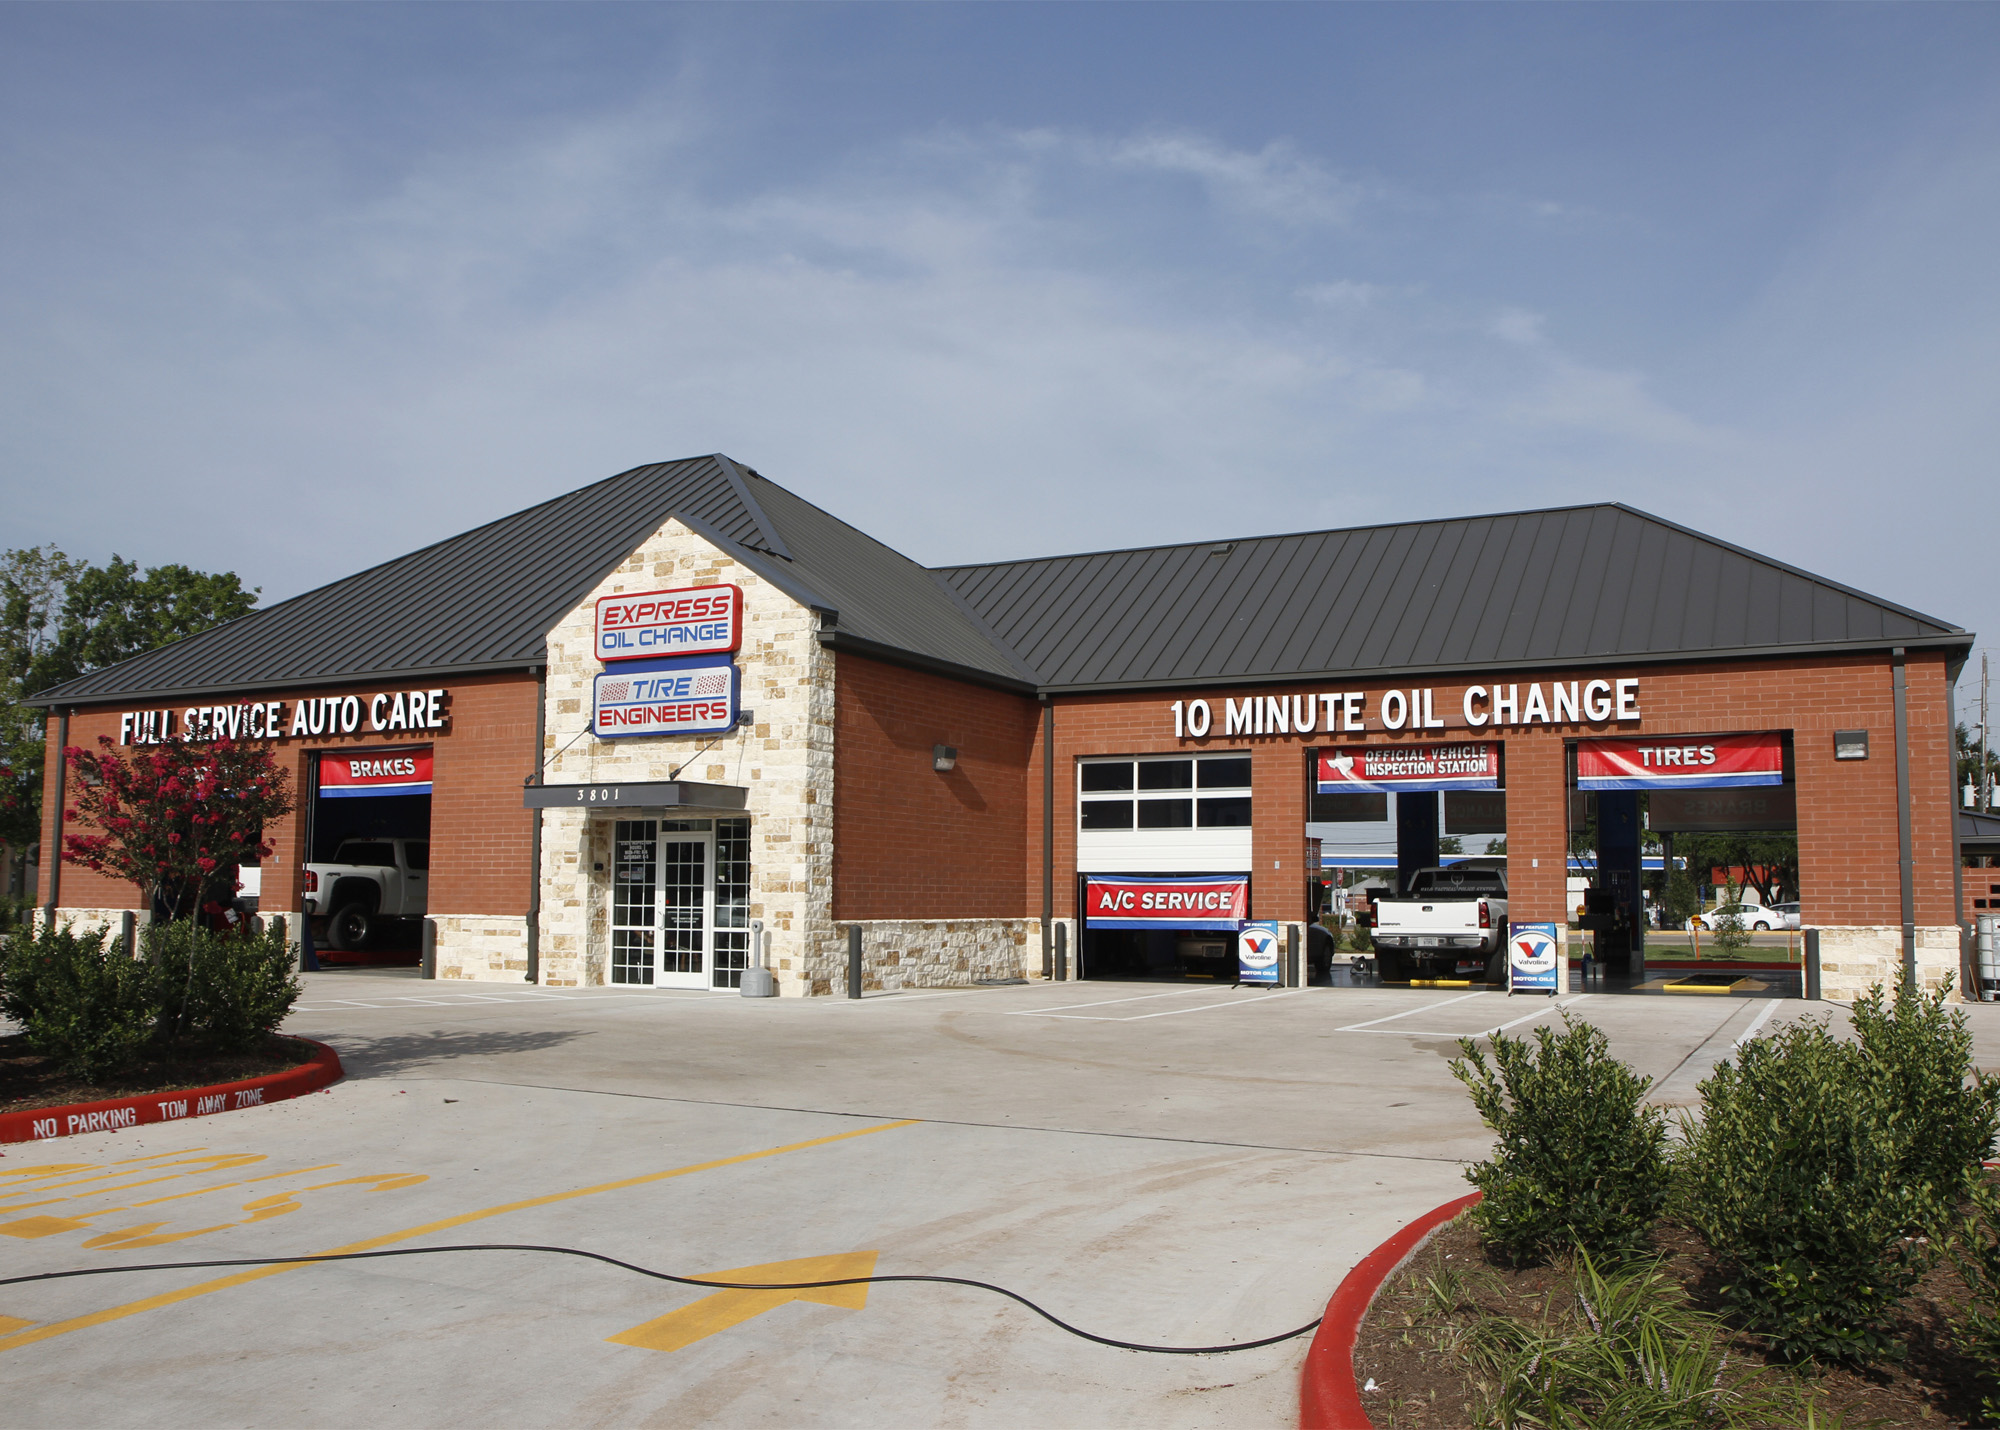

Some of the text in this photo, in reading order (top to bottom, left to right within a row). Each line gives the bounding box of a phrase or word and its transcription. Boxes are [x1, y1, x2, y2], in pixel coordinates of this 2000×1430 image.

[603, 595, 731, 625] EXPRESS
[602, 623, 728, 649] OIL CHANGE
[632, 676, 692, 699] TIRE
[120, 689, 446, 746] FULL SERVICE AUTO CARE
[599, 702, 727, 726] ENGINEERS
[1170, 678, 1641, 738] 10 MINUTE OIL CHANGE
[1365, 745, 1488, 762] OFFICIAL VEHICLE
[1638, 745, 1716, 767] TIRES
[349, 757, 416, 778] BRAKES
[1365, 759, 1488, 776] INSPECTION STATION
[577, 788, 620, 801] 3801
[1099, 890, 1233, 911] A/C SERVICE
[33, 1088, 265, 1140] NO PARKING TOW AWAY ZONE
